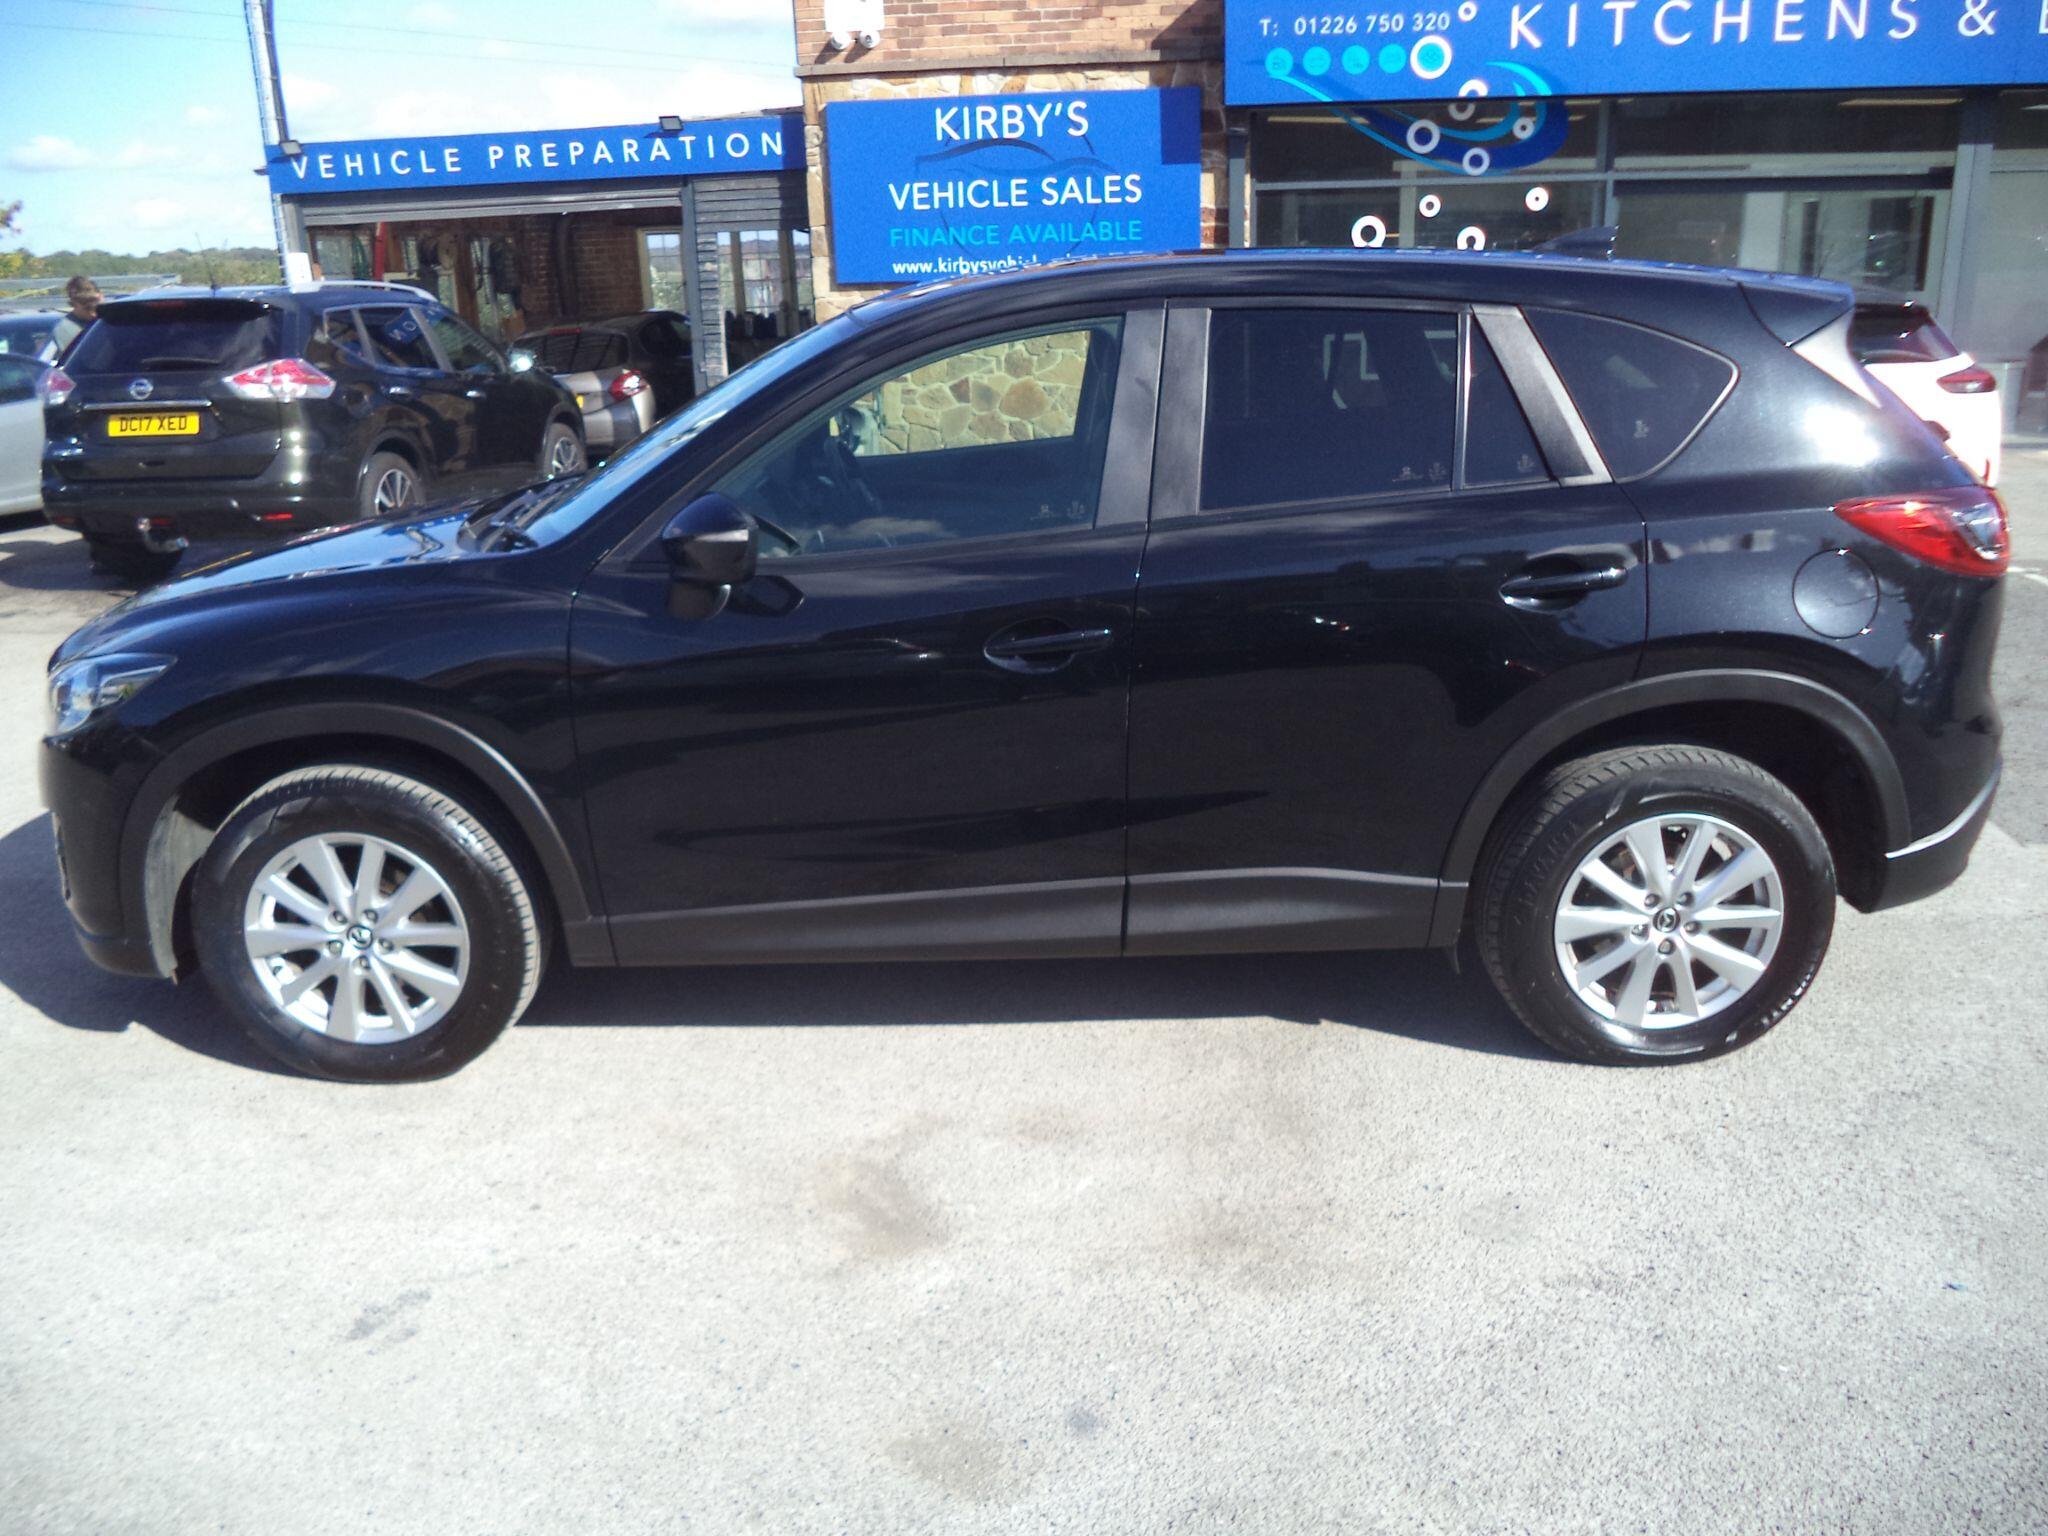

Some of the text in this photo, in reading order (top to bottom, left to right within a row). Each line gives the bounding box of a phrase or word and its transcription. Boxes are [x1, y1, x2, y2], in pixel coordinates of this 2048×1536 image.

[1294, 15, 1358, 35] 01226
[1366, 14, 1404, 33] 750
[1412, 12, 1450, 32] 320
[1510, 0, 1919, 49] KITCHENS
[1957, 0, 1998, 37] &
[935, 101, 1090, 141] KIRBY'S
[291, 132, 785, 180] VEHICLE PREPARATION
[888, 174, 1142, 211] VEHICLE SALES
[889, 220, 1143, 249] FINANCE AVAILABLE
[119, 416, 187, 432] DC17 XED
